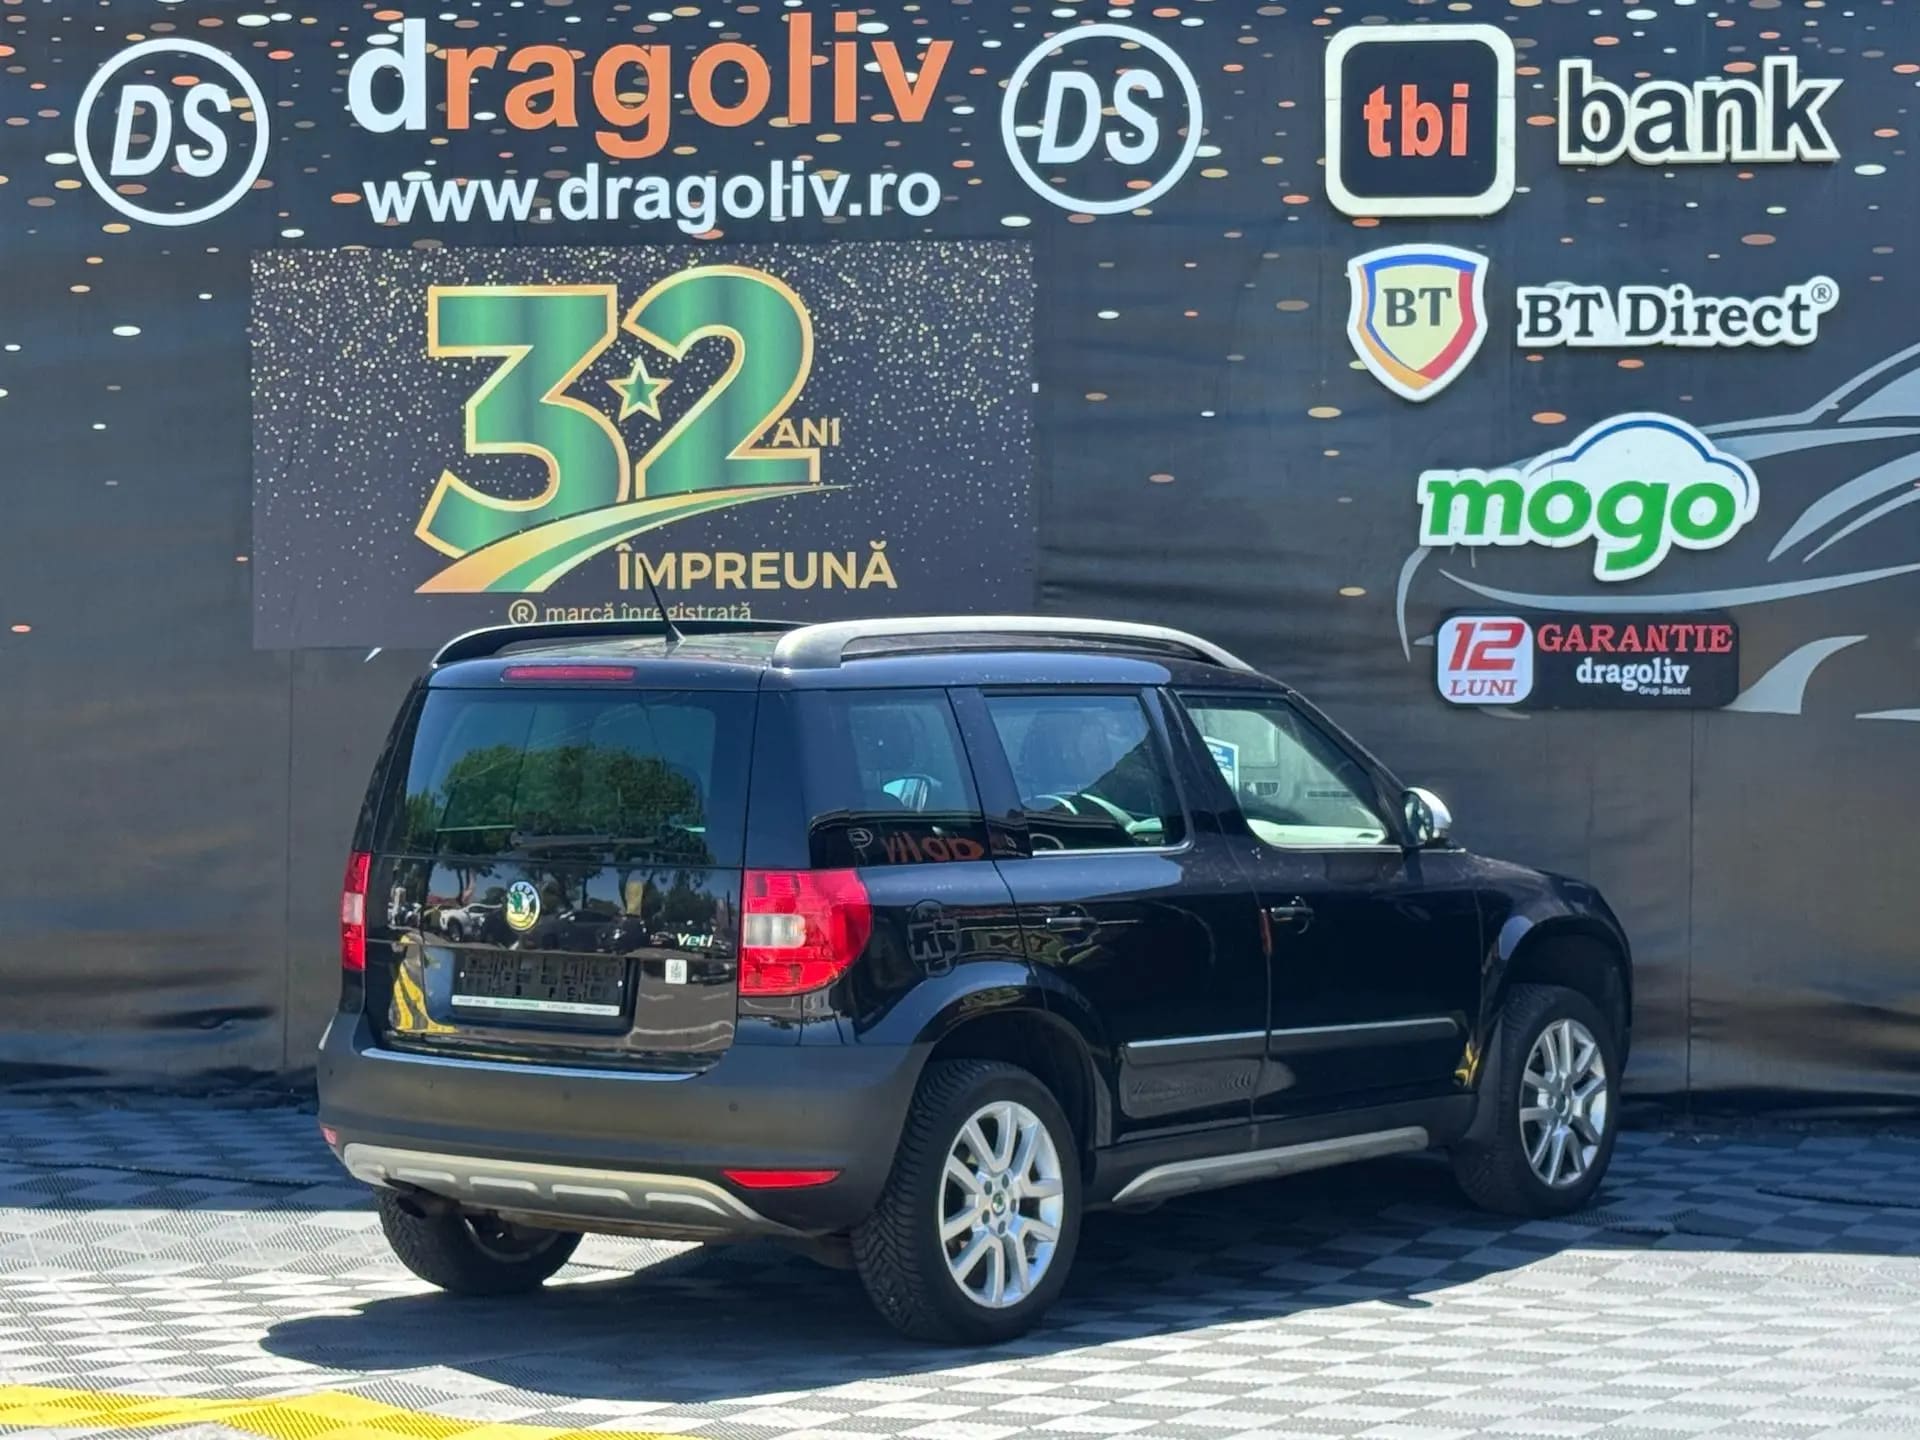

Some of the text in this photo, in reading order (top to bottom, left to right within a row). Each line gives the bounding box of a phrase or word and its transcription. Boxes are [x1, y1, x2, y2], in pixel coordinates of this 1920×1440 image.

[347, 11, 953, 159] dragoliv
[110, 83, 232, 177] DS
[1037, 69, 1164, 165] DS
[1363, 59, 1838, 161] tbi bank
[363, 160, 941, 235] www.dragoliv.ro
[1383, 287, 1452, 327] BT
[1524, 292, 1604, 338] BT
[414, 264, 821, 559] 32
[772, 418, 840, 447] ANI
[1427, 478, 1736, 571] mogo
[614, 542, 898, 590] ÎMPREUNĂ
[546, 602, 614, 621] marcă
[1448, 622, 1525, 671] 12
[1537, 624, 1732, 652] GARANTIE
[1449, 679, 1517, 697] LUNI
[1576, 657, 1690, 690] dragoliv
